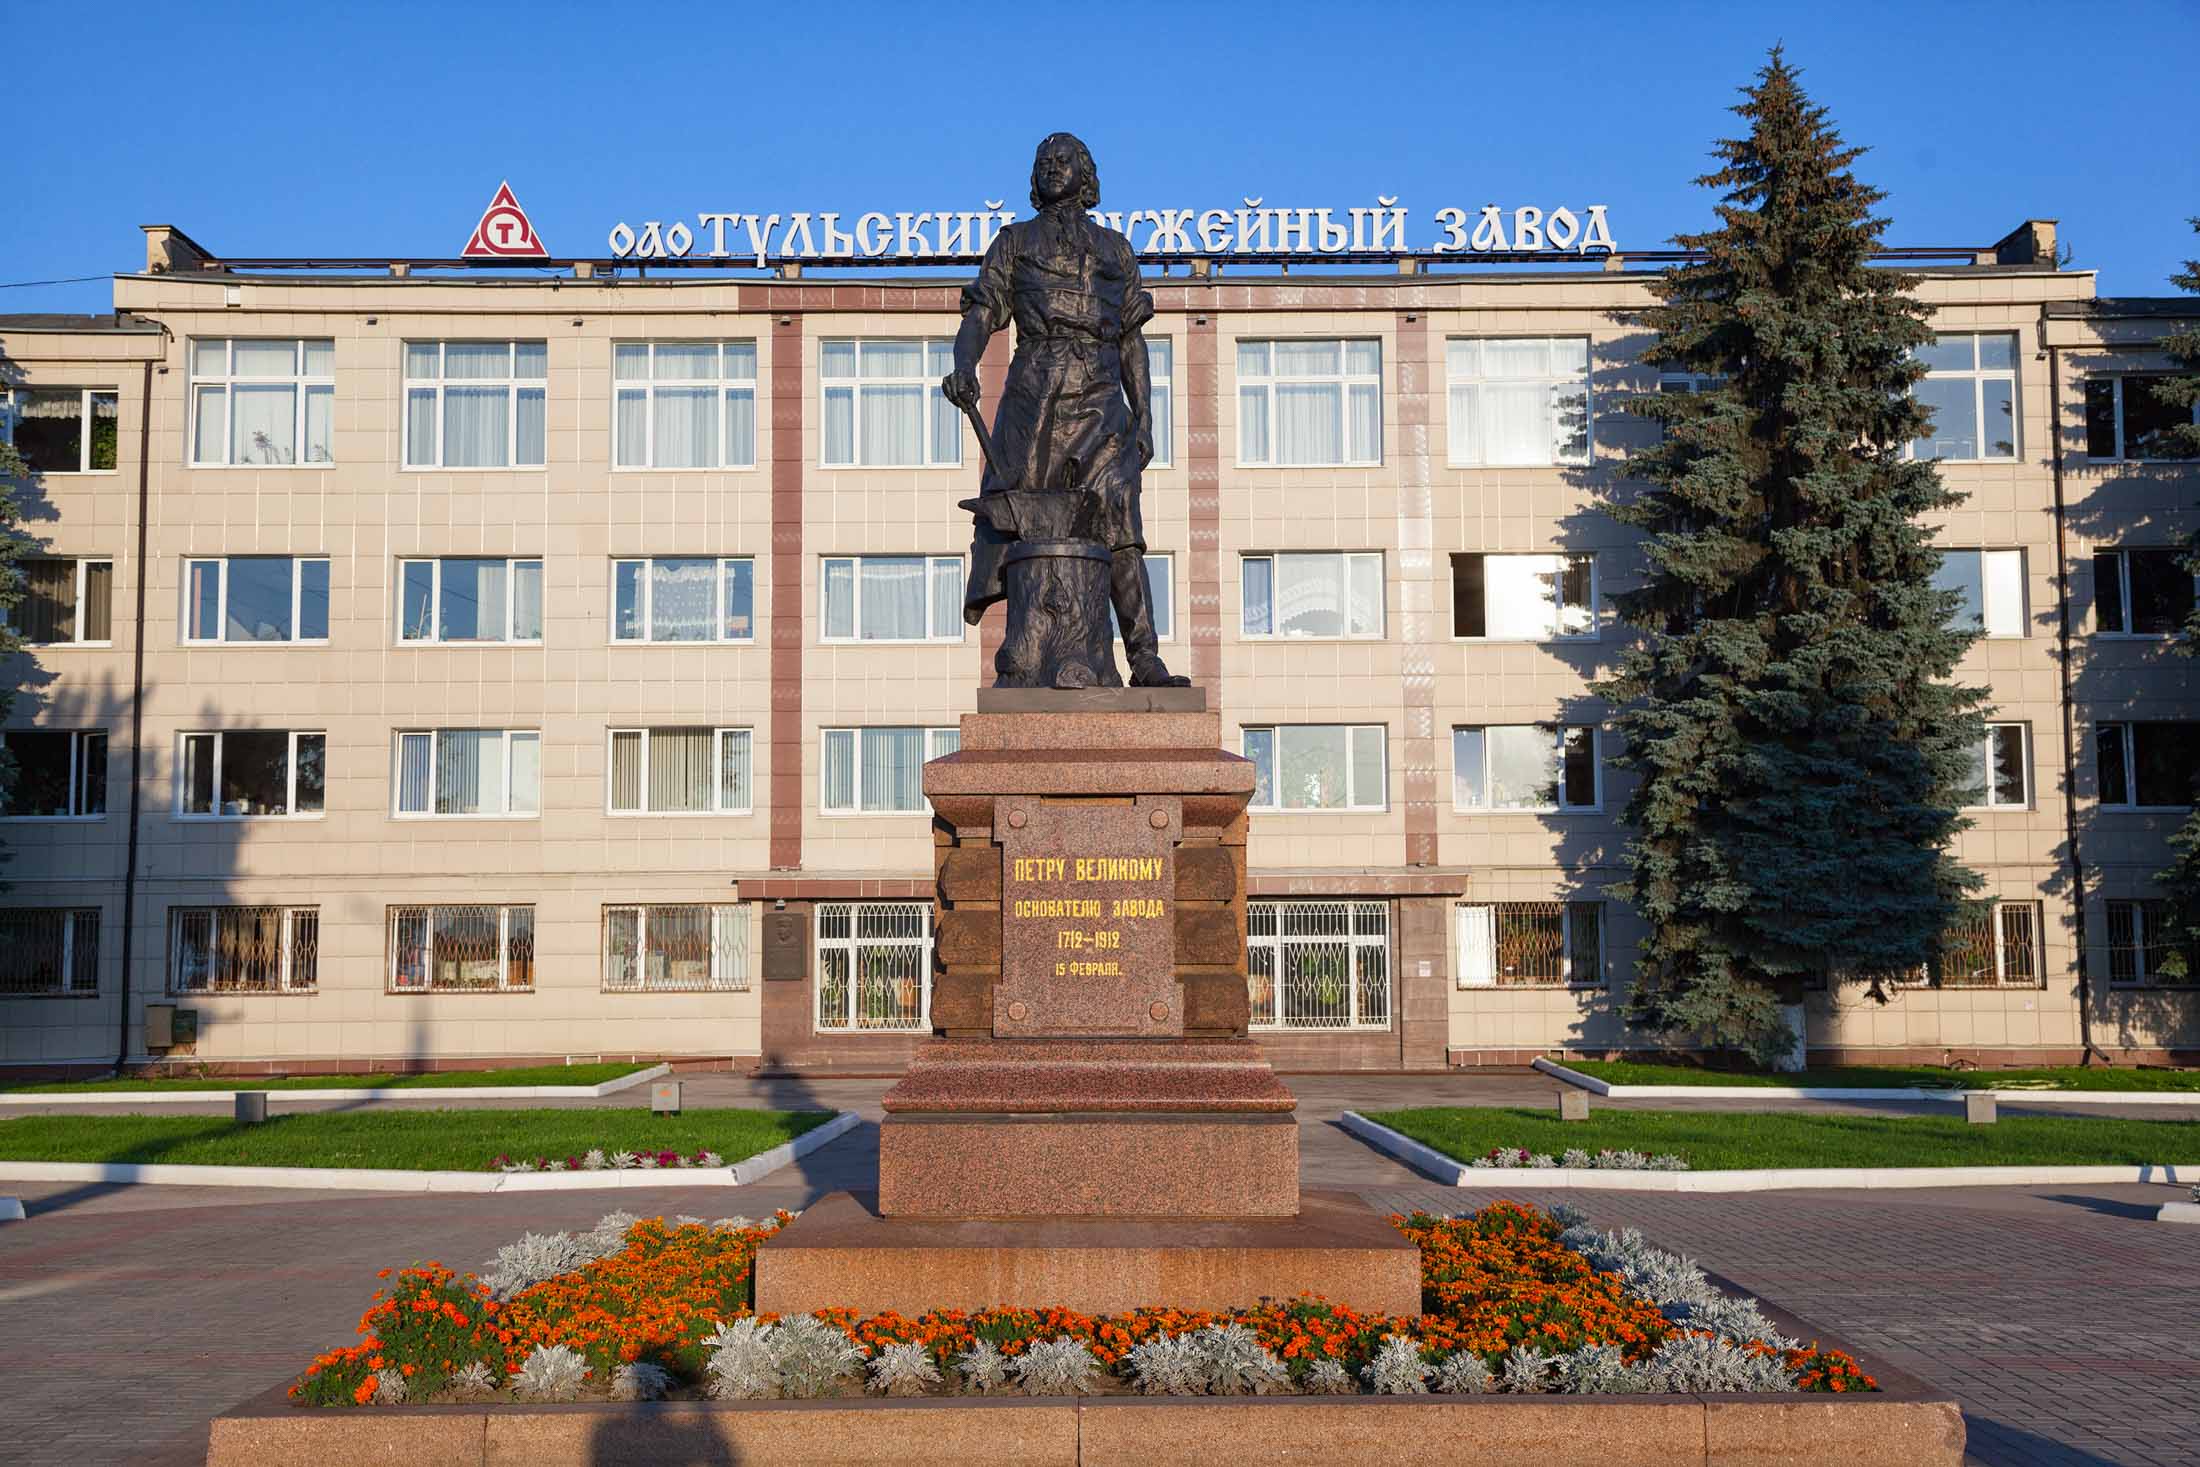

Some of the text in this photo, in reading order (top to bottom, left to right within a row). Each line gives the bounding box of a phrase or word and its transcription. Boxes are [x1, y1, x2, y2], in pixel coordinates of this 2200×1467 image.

[697, 199, 1017, 269] ТУЛЬСКИЙ
[1085, 195, 1409, 254] УЖЕЙНЫЙ
[1432, 204, 1617, 255] ЗАВОД
[1014, 857, 1066, 882] ПЕТРУ
[1015, 899, 1165, 919] ОСНОВАТЕЛЮ ЗАВОДА
[1055, 960, 1123, 976] 15 ФЕВРАЛЯ.
